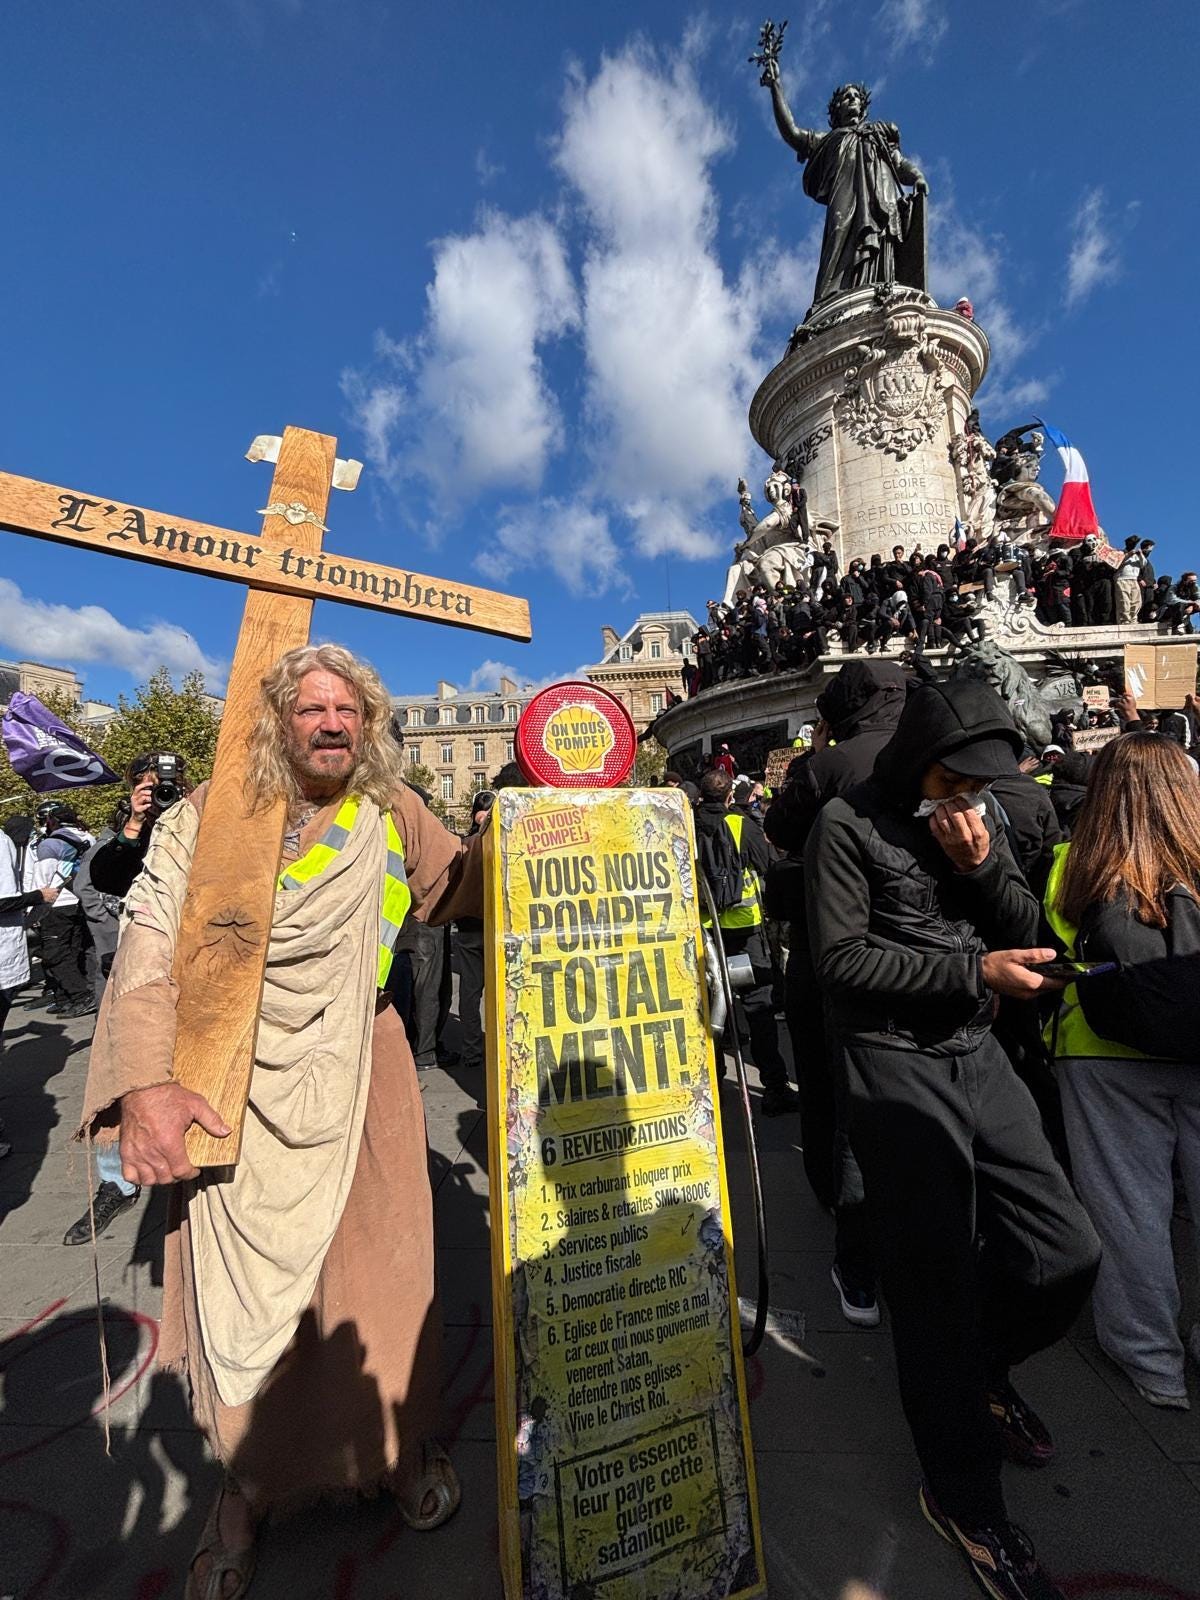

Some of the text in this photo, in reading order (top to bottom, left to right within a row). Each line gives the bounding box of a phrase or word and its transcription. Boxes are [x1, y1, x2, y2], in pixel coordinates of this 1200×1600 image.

[856, 502, 951, 522] RÉPUBLIQUE
[51, 494, 475, 616] L'Amour triomphera
[551, 721, 606, 738] ON VOUS
[526, 810, 582, 834] ON VOUS
[532, 825, 584, 849] POMPE!
[524, 851, 671, 898] VOUS NOUS
[528, 893, 677, 955] POMPEZ
[531, 948, 684, 1028] TOTAL
[535, 1017, 691, 1106] MENT!
[541, 1115, 688, 1167] 6 REVENDICATIONS
[540, 1160, 692, 1204] 1. Prix carburant bloquer prix
[540, 1181, 711, 1232] 2. Salaires & retraites SMIC 1800€
[542, 1224, 649, 1260] 3. Services publics
[544, 1250, 642, 1288] 4. Justice fiscale
[546, 1265, 687, 1317] 5. Democratie directe RIC
[547, 1325, 560, 1346] 6.
[563, 1317, 598, 1345] Eglise
[600, 1313, 613, 1333] de
[616, 1305, 653, 1329] France
[655, 1297, 680, 1320] mise
[691, 1288, 710, 1311] mal
[565, 1310, 710, 1363] car ceux qui nous gouvernent
[566, 1350, 653, 1385] venerent Satan,
[567, 1380, 618, 1408] defendre
[621, 1374, 642, 1395] nos
[644, 1363, 682, 1390] eglises
[568, 1387, 670, 1433] Vive le Christ Roi.
[573, 1431, 699, 1492] Votre essence
[573, 1457, 704, 1519] leur paye cette
[616, 1492, 673, 1534] guerre
[598, 1514, 692, 1566] satanique.
